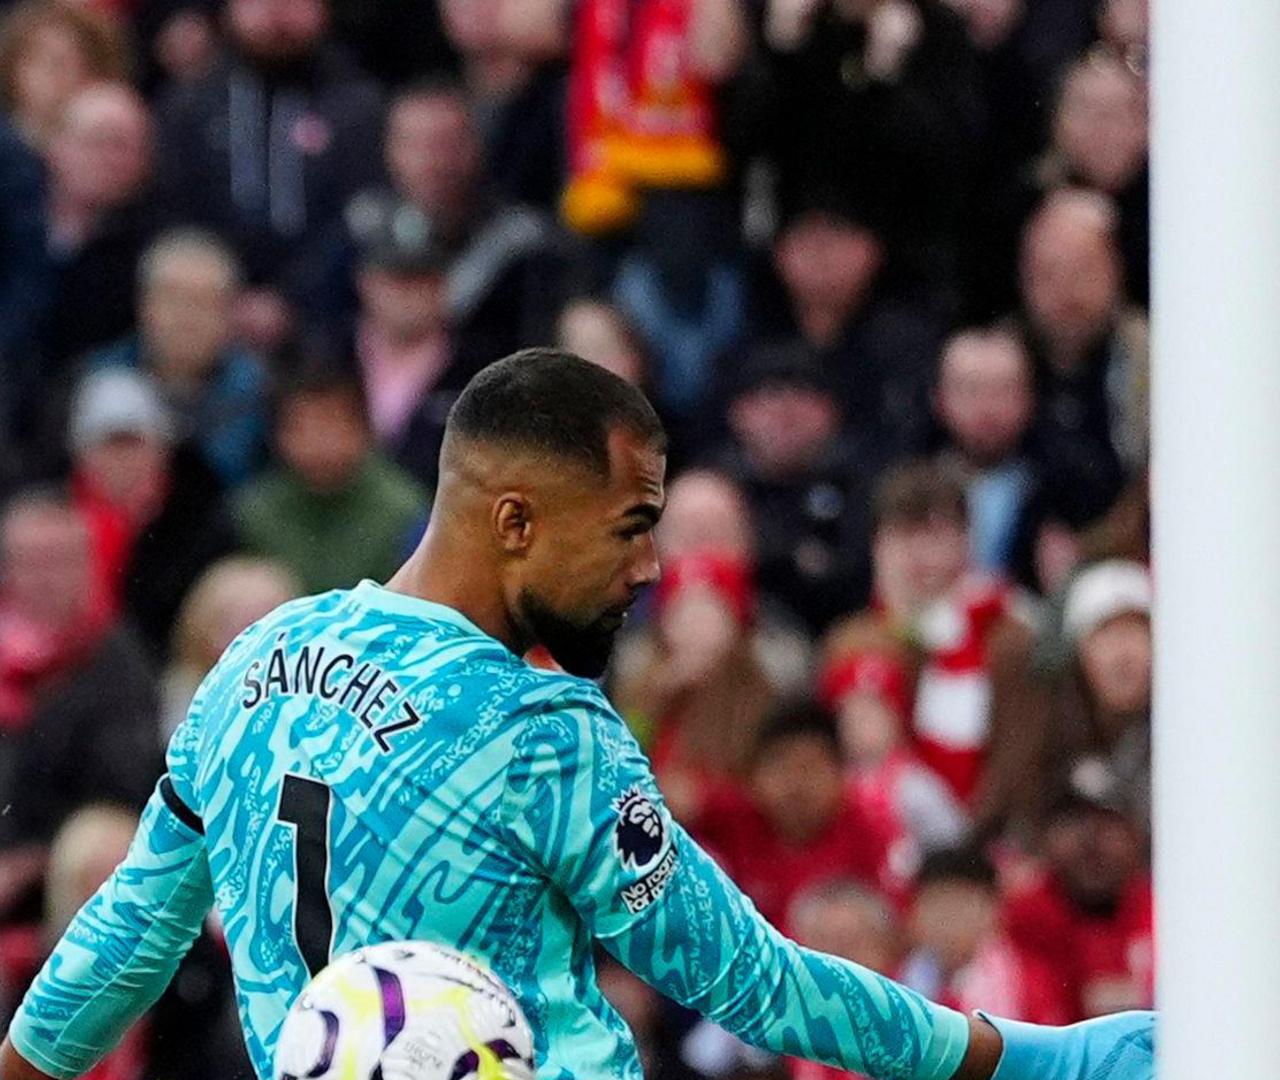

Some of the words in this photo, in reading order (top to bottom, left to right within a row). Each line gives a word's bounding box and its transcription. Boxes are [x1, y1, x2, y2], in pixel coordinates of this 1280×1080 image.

[243, 632, 420, 753] SÁNCHEZ
[277, 773, 333, 978] 1
[621, 883, 647, 904] No
